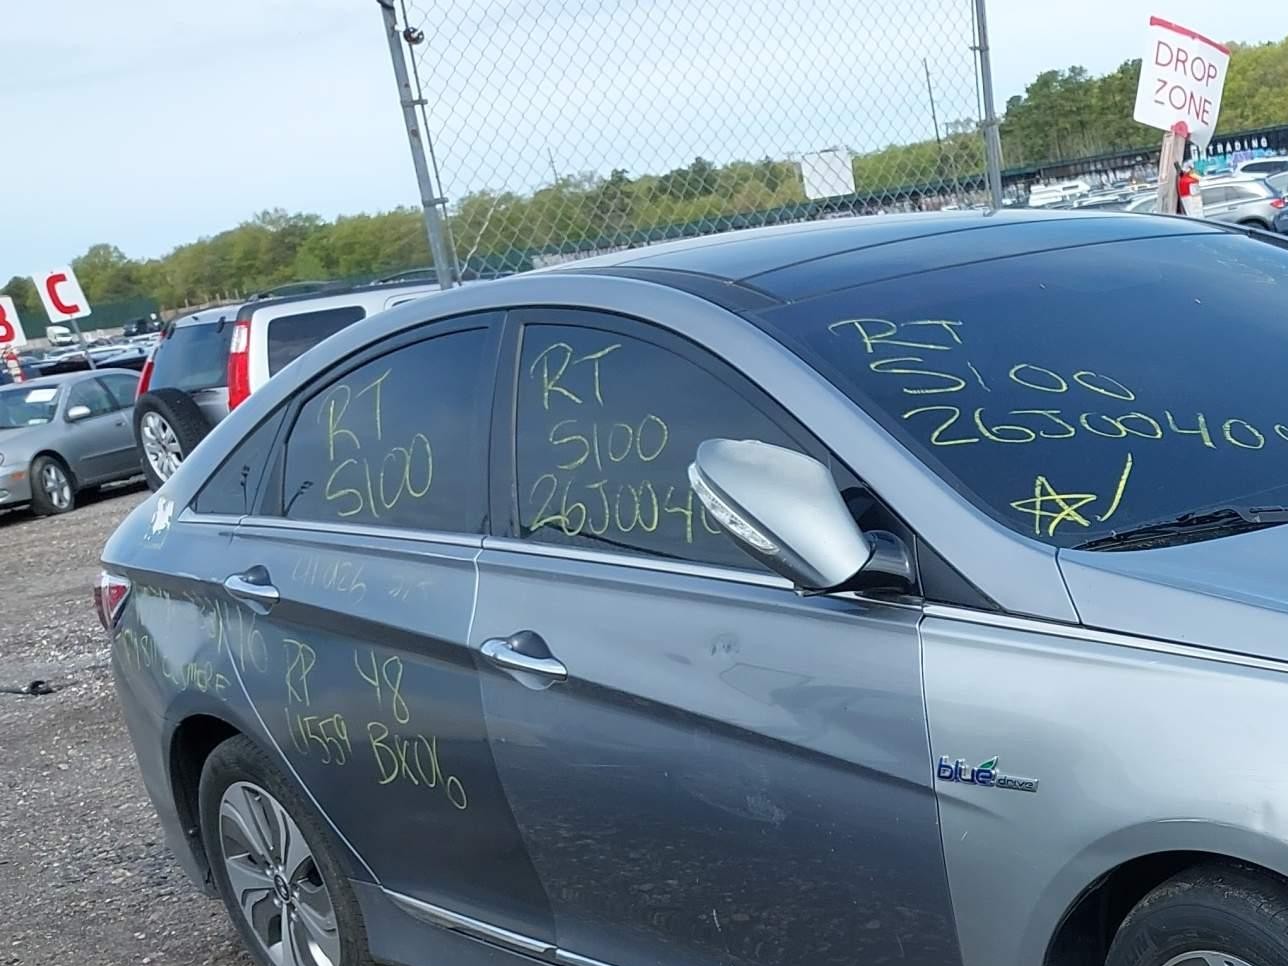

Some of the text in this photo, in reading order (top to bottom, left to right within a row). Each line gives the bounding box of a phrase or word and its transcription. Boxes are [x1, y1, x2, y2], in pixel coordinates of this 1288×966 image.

[1155, 40, 1217, 87] DROP
[1154, 78, 1212, 126] ZONE
[46, 273, 80, 315] C
[828, 318, 963, 353] RT
[530, 342, 622, 410] RT
[316, 367, 393, 461] RT
[936, 755, 1036, 791] blue drive
